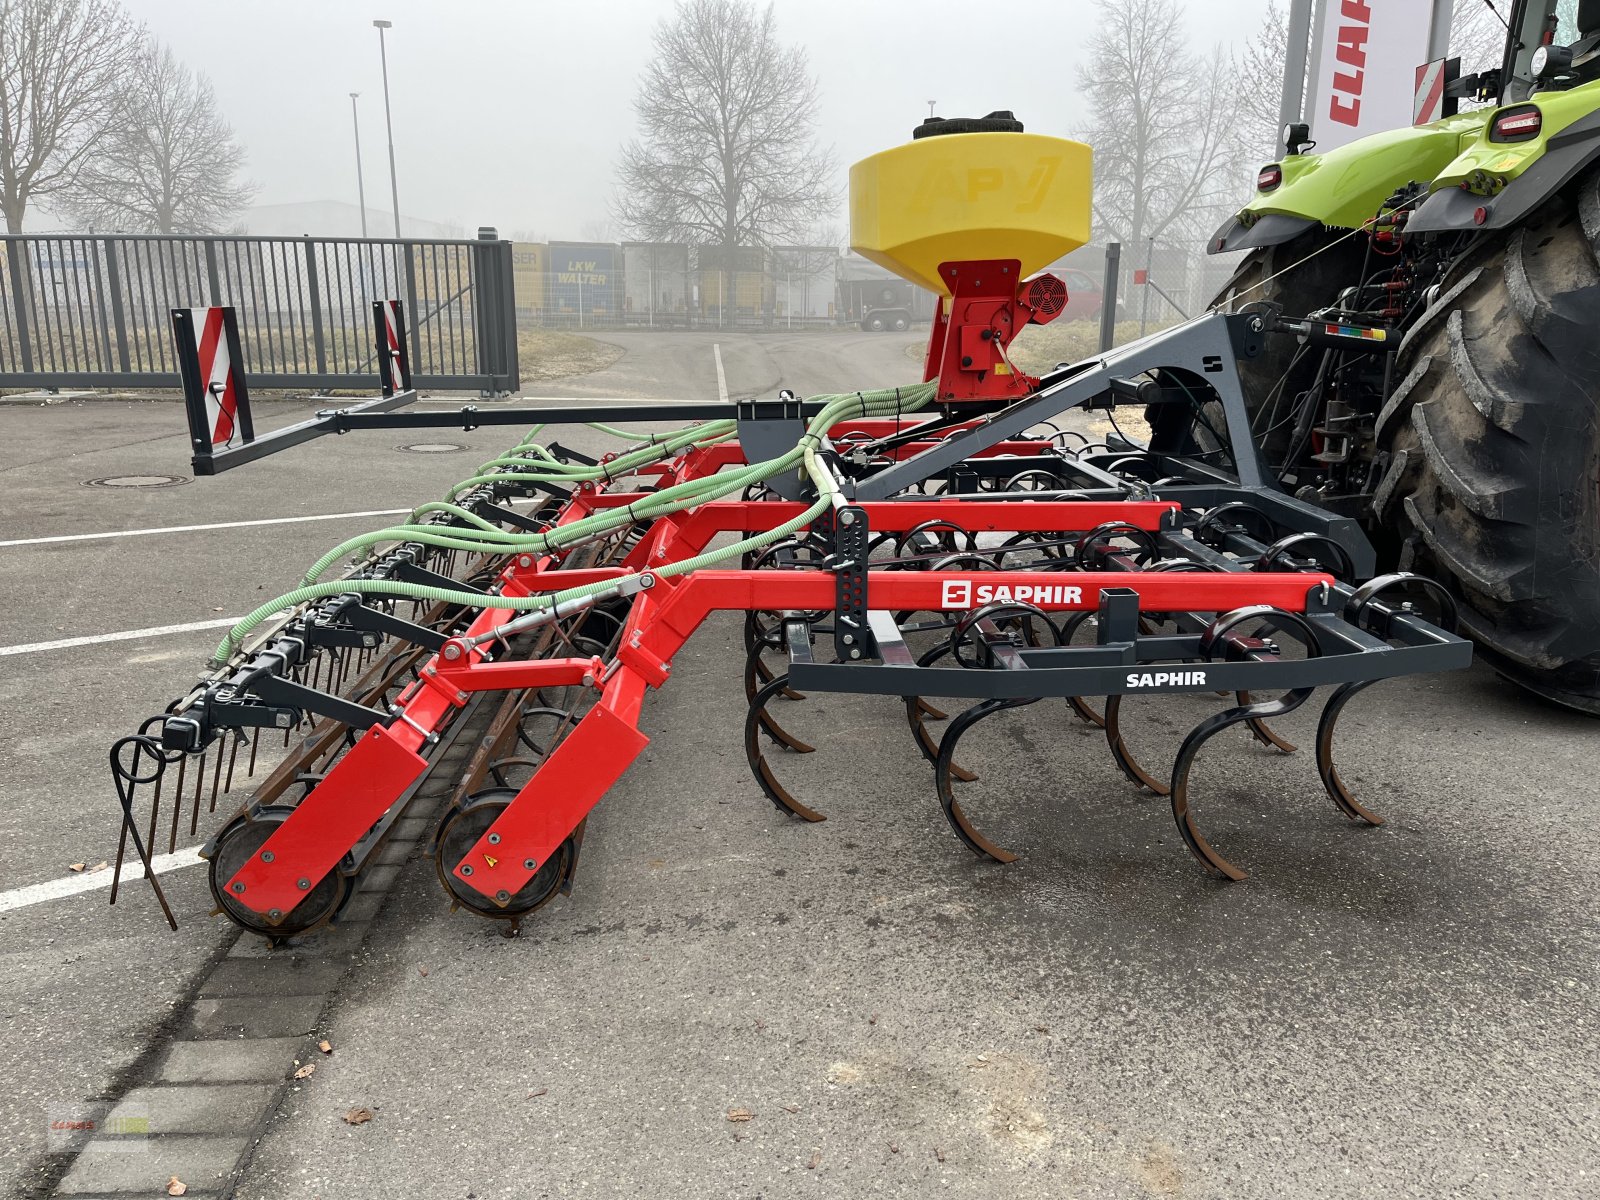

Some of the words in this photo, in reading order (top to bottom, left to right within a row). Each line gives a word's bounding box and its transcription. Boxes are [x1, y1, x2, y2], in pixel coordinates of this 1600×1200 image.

[568, 261, 596, 272] LKW
[558, 272, 607, 285] WALTER
[976, 585, 1082, 604] SAPHIR
[1126, 671, 1206, 688] SAPHIR
